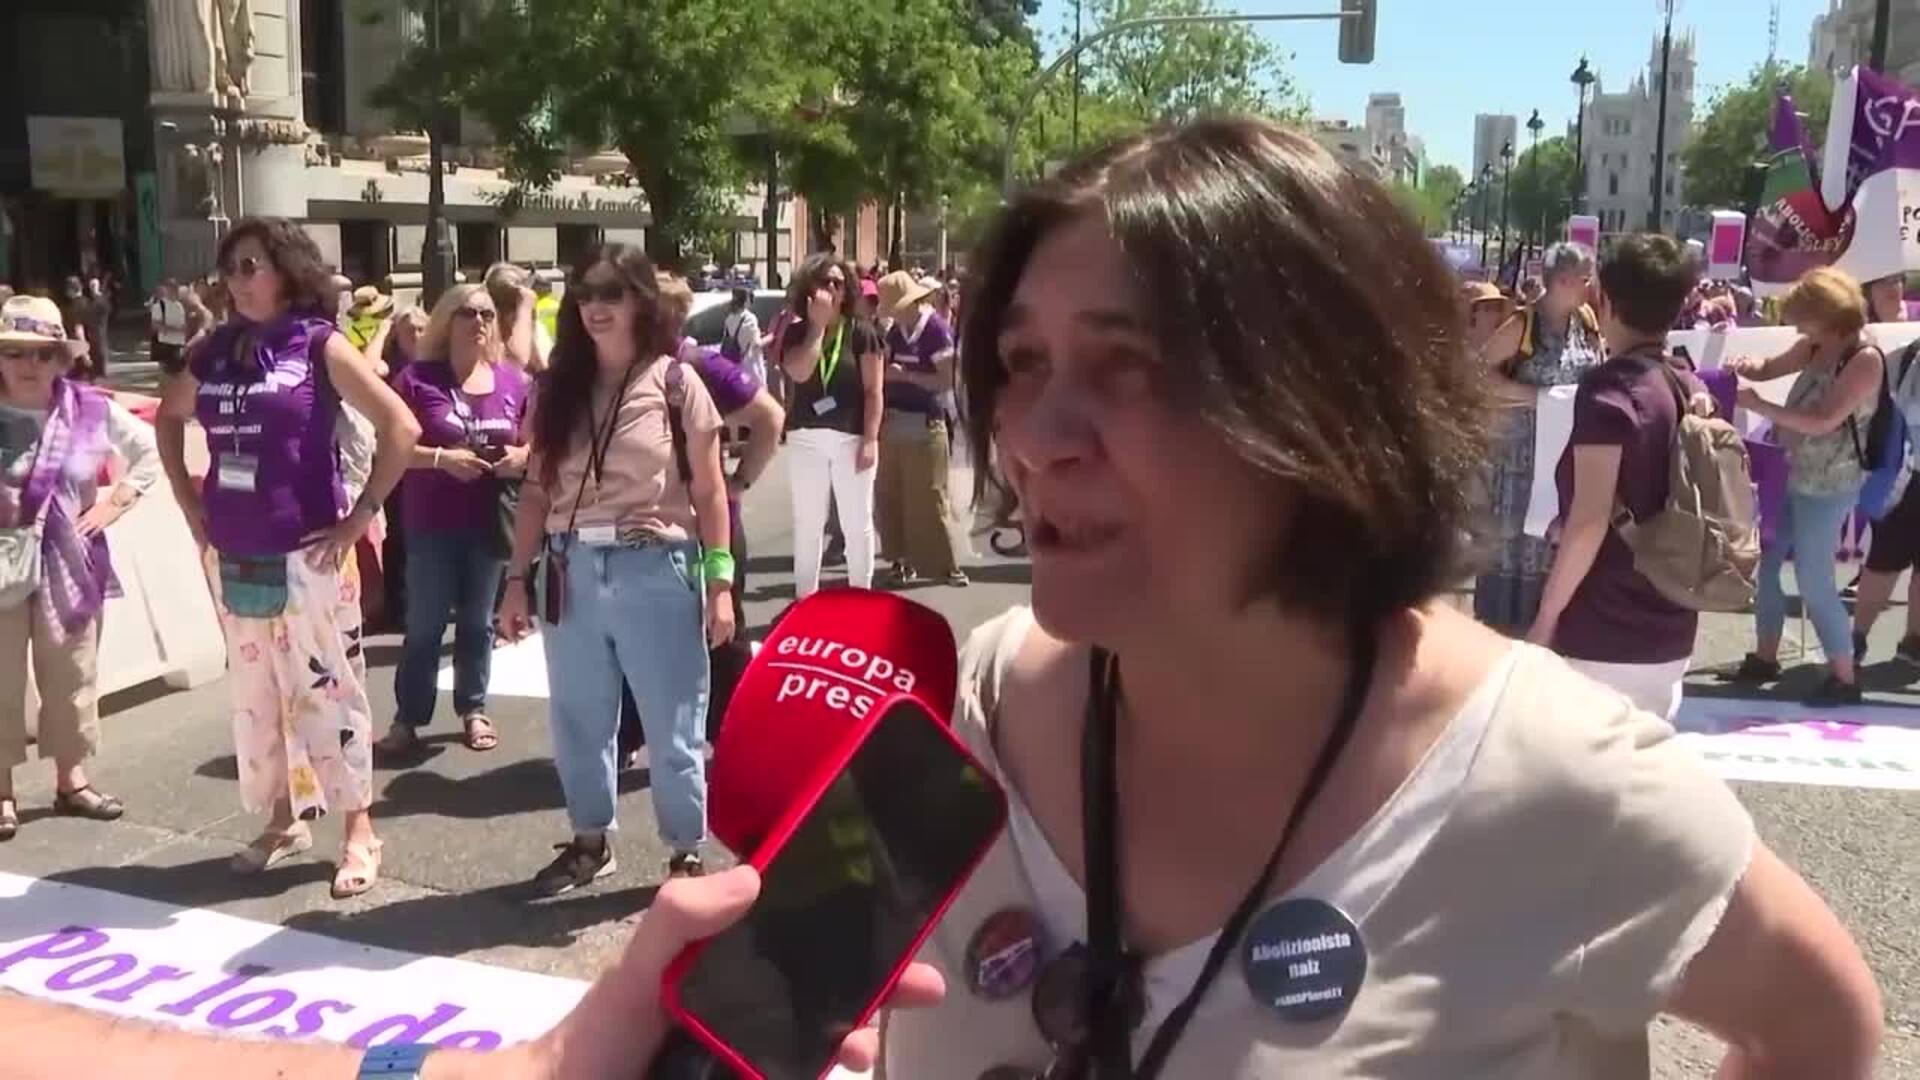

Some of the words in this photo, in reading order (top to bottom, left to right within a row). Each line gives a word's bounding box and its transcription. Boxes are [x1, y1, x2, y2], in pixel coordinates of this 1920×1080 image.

[777, 635, 917, 694] europa
[776, 673, 875, 720] pres
[1252, 932, 1351, 961] Abolizionista
[1288, 959, 1321, 980] naiz
[0, 925, 195, 1003] Por
[155, 964, 356, 1038] los
